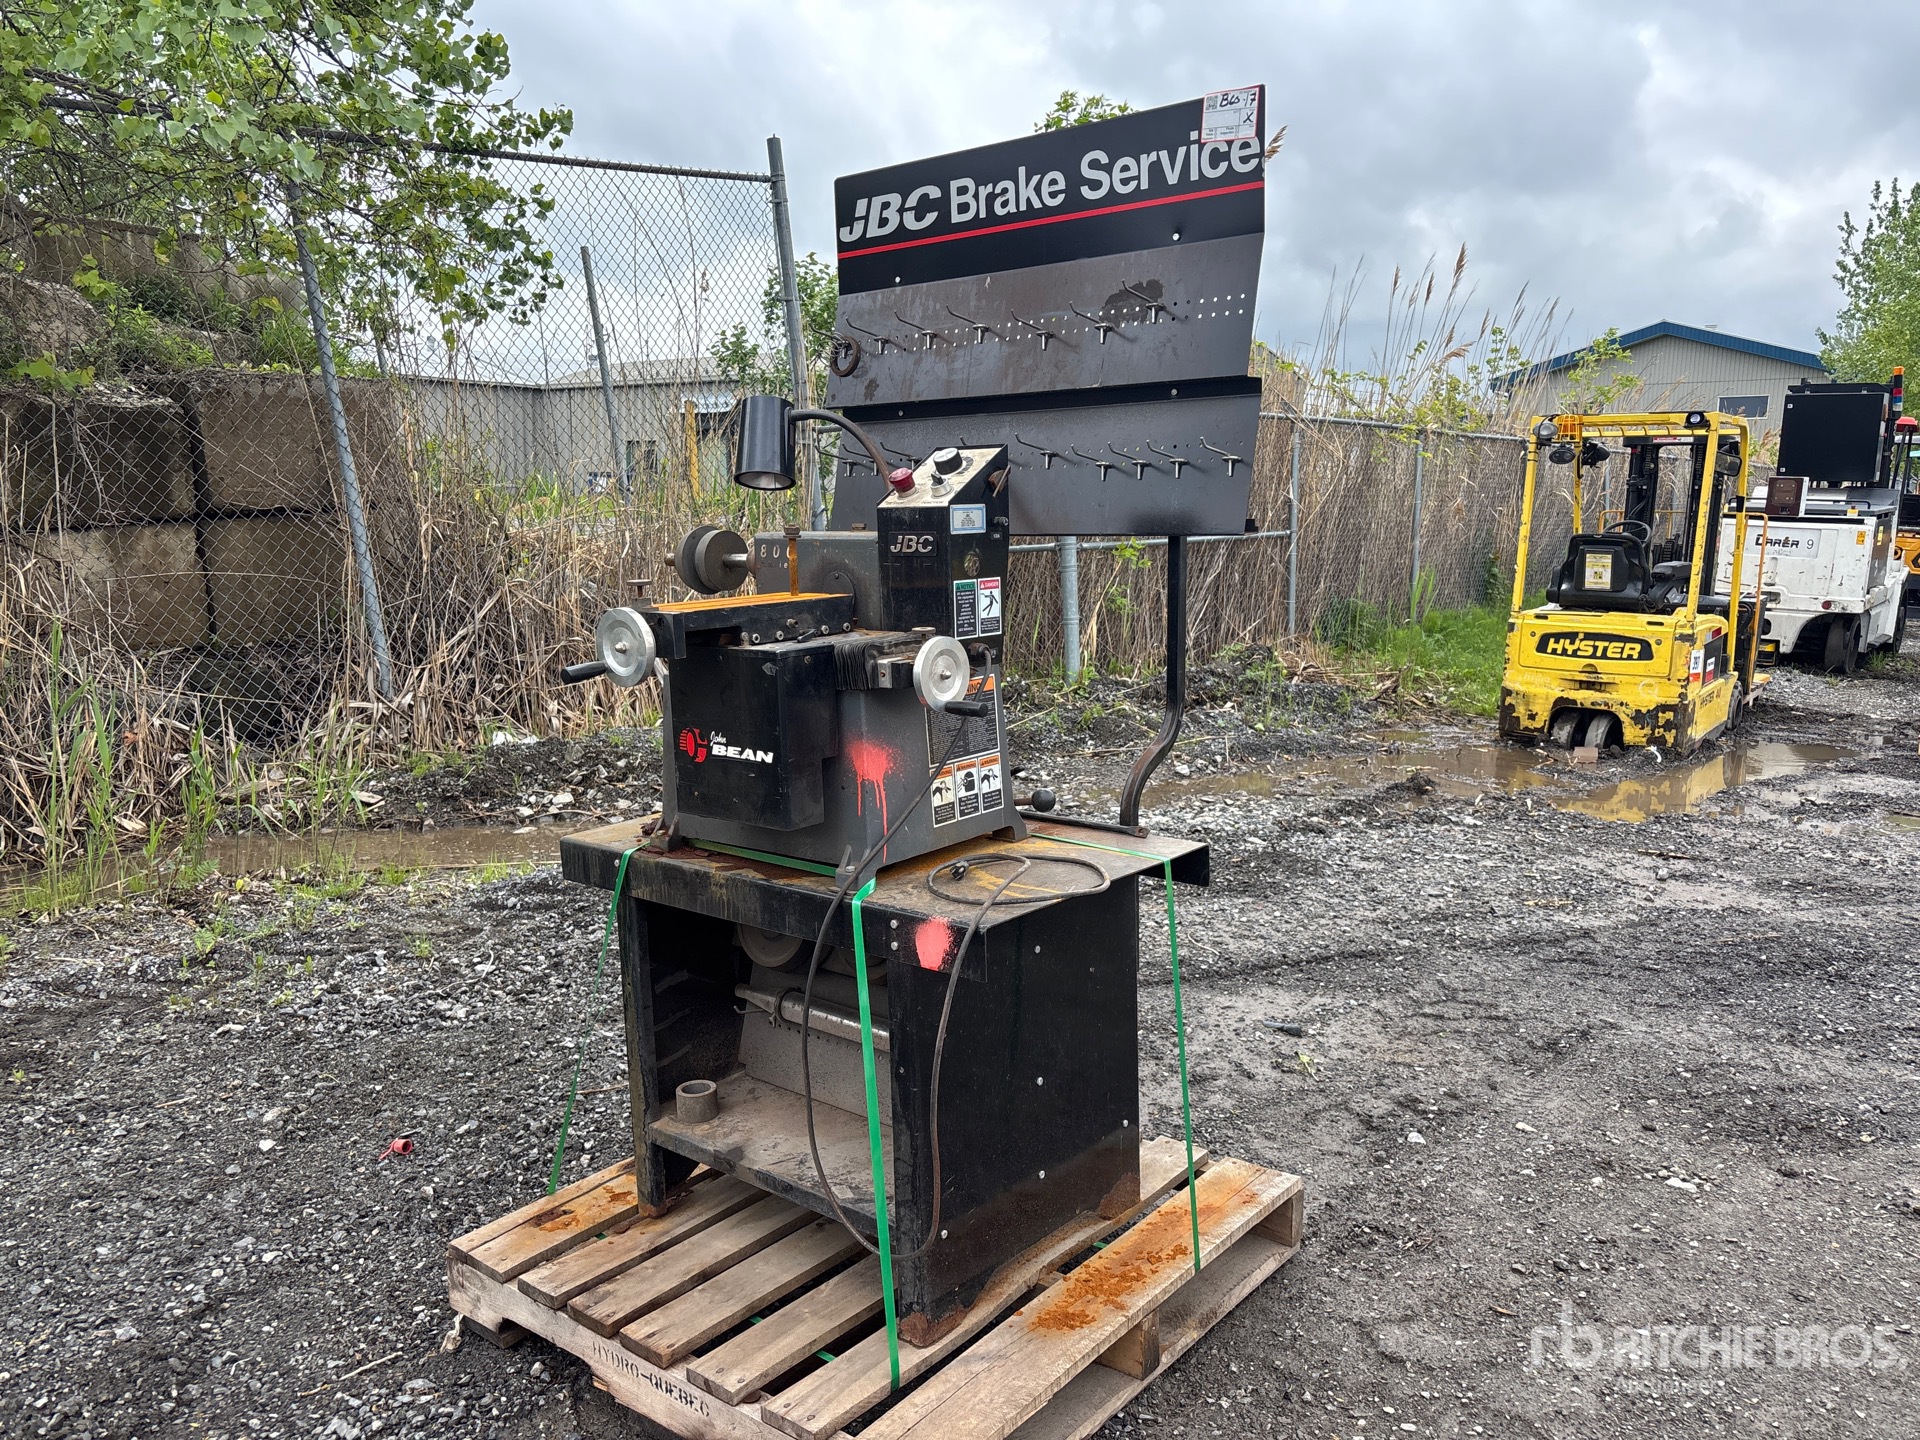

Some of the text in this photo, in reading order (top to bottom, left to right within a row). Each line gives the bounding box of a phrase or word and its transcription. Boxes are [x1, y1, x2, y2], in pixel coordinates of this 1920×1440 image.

[839, 129, 1261, 243] JBC Brake Service
[890, 535, 934, 553] JBC
[1806, 539, 1814, 550] 9
[1546, 637, 1642, 659] HYSTER
[710, 731, 727, 746] John
[711, 744, 774, 763] BEAN
